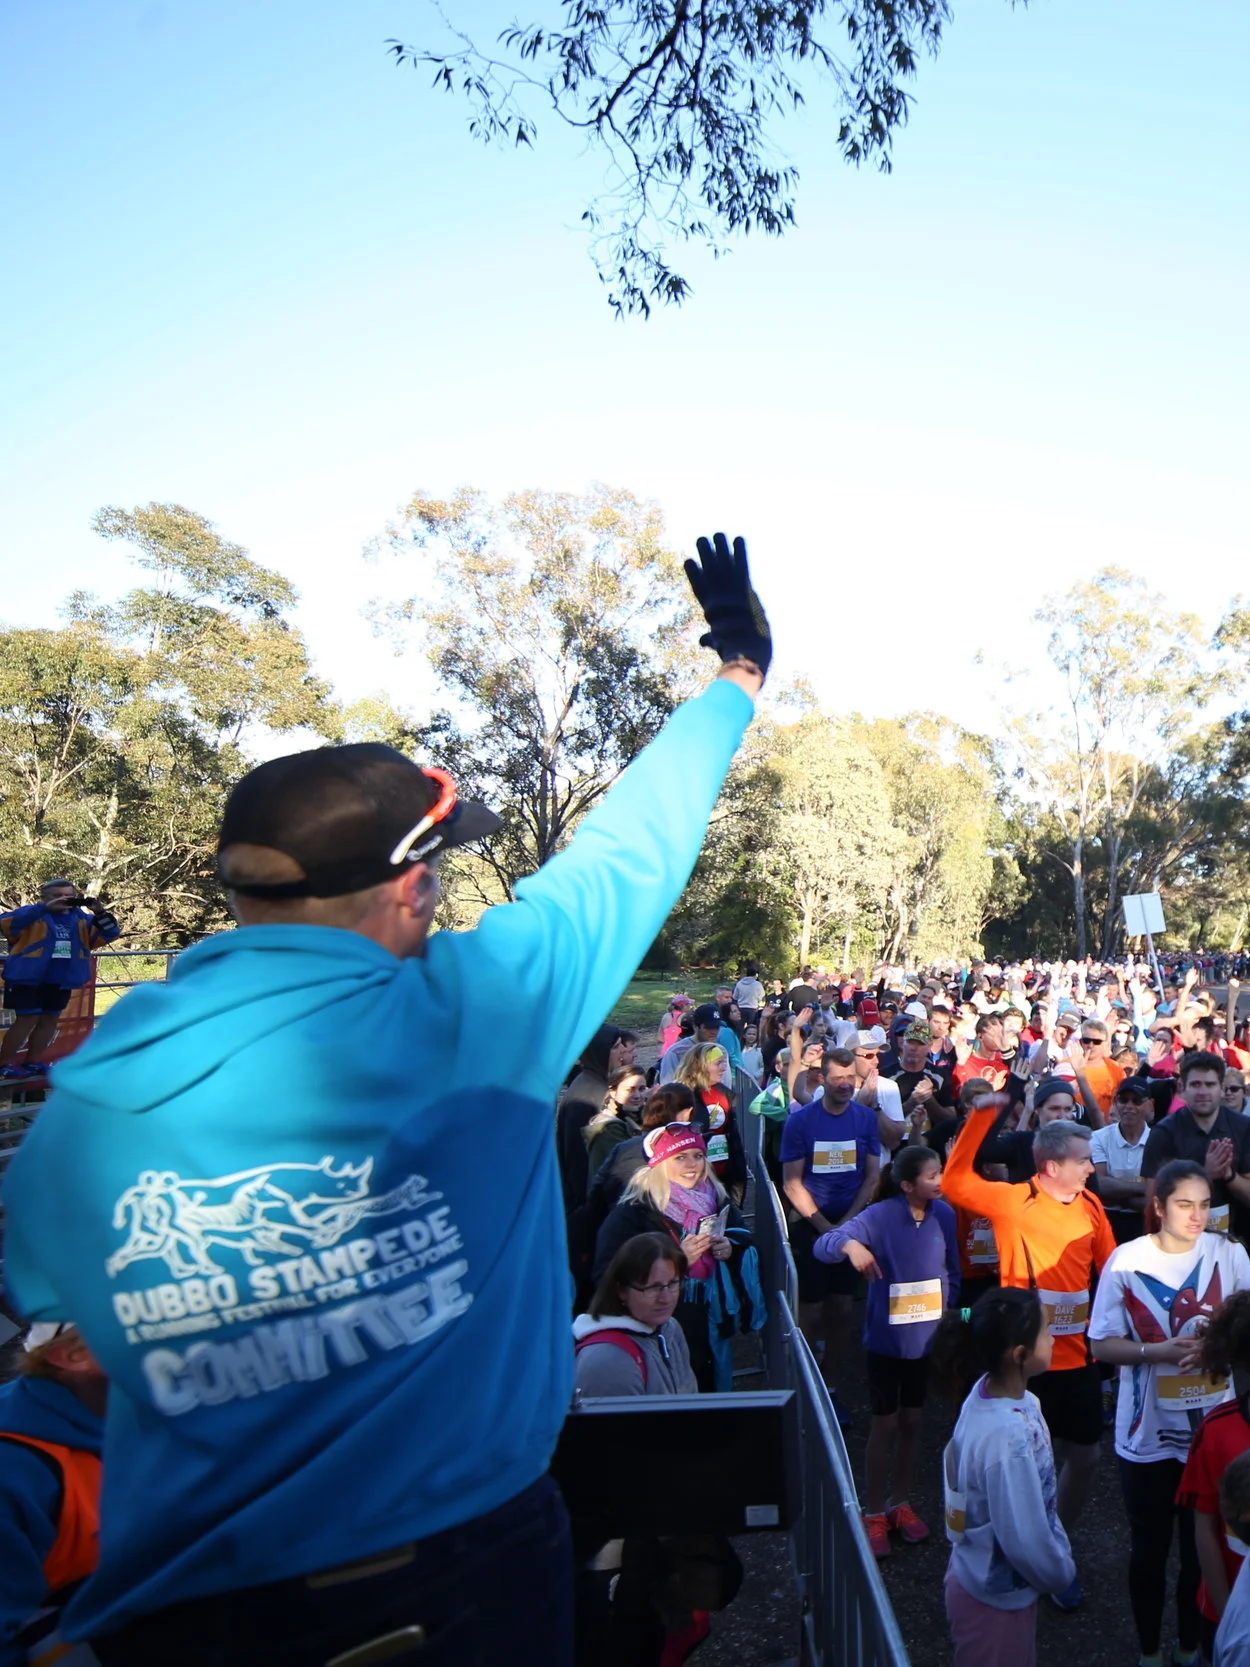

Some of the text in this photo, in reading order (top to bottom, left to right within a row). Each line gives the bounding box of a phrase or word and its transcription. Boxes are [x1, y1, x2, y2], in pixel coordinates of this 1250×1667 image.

[666, 1137, 696, 1153] HANSEN
[112, 1205, 459, 1328] DUBBO STAMPEDE
[314, 1277, 361, 1303] FOR
[362, 1233, 465, 1290] EVERYONE
[907, 1303, 927, 1313] 2746
[1054, 1305, 1076, 1315] DAVE
[1054, 1315, 1073, 1325] 1623
[1179, 1385, 1206, 1398] 2504
